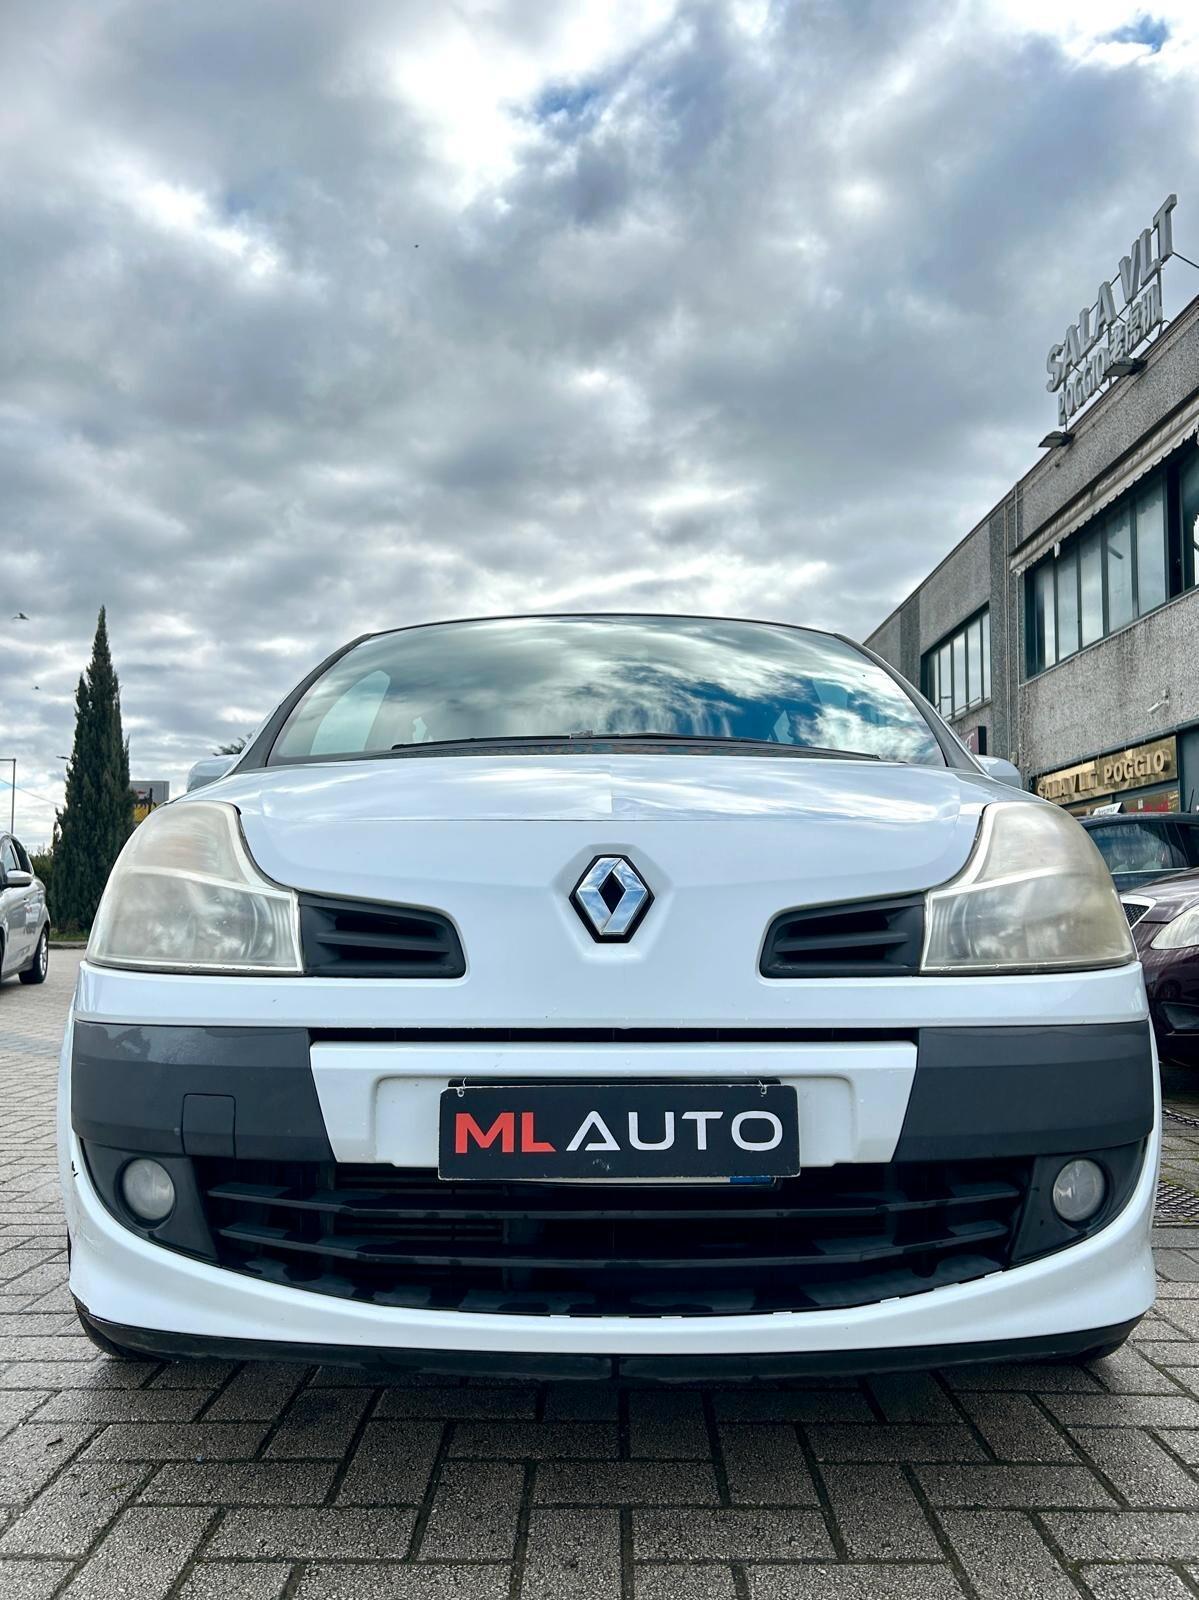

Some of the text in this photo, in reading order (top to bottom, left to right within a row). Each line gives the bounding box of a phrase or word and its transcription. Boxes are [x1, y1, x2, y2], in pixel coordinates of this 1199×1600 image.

[1046, 193, 1177, 392] SALA VLT
[1058, 346, 1110, 426] POGGIO
[1103, 750, 1165, 785] POGGIO
[455, 1110, 783, 1154] ML AUTO
